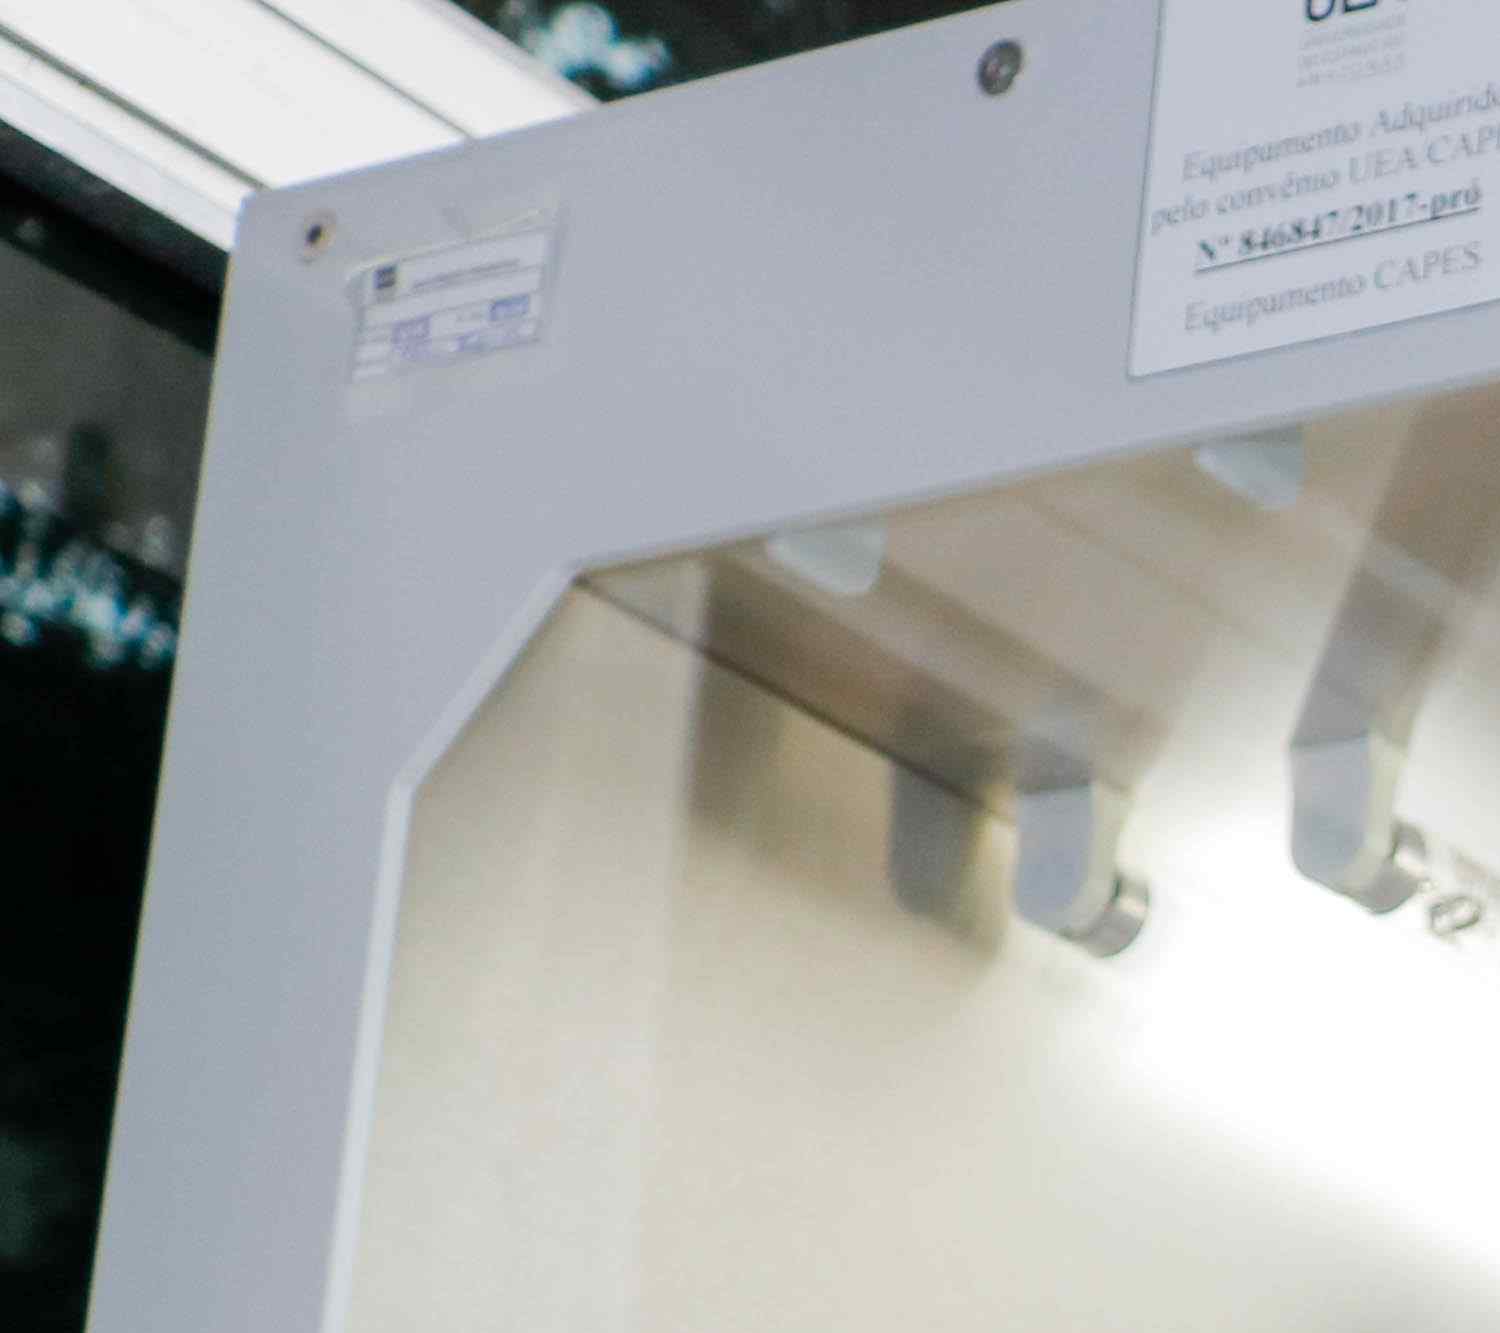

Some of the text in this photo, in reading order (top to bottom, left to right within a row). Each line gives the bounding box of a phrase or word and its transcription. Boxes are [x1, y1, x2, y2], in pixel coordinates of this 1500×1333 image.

[1151, 197, 1209, 234] pelo
[1349, 145, 1418, 183] UEA
[1183, 121, 1361, 183] Equipamento
[1184, 240, 1483, 332] Equipamento CAPES
